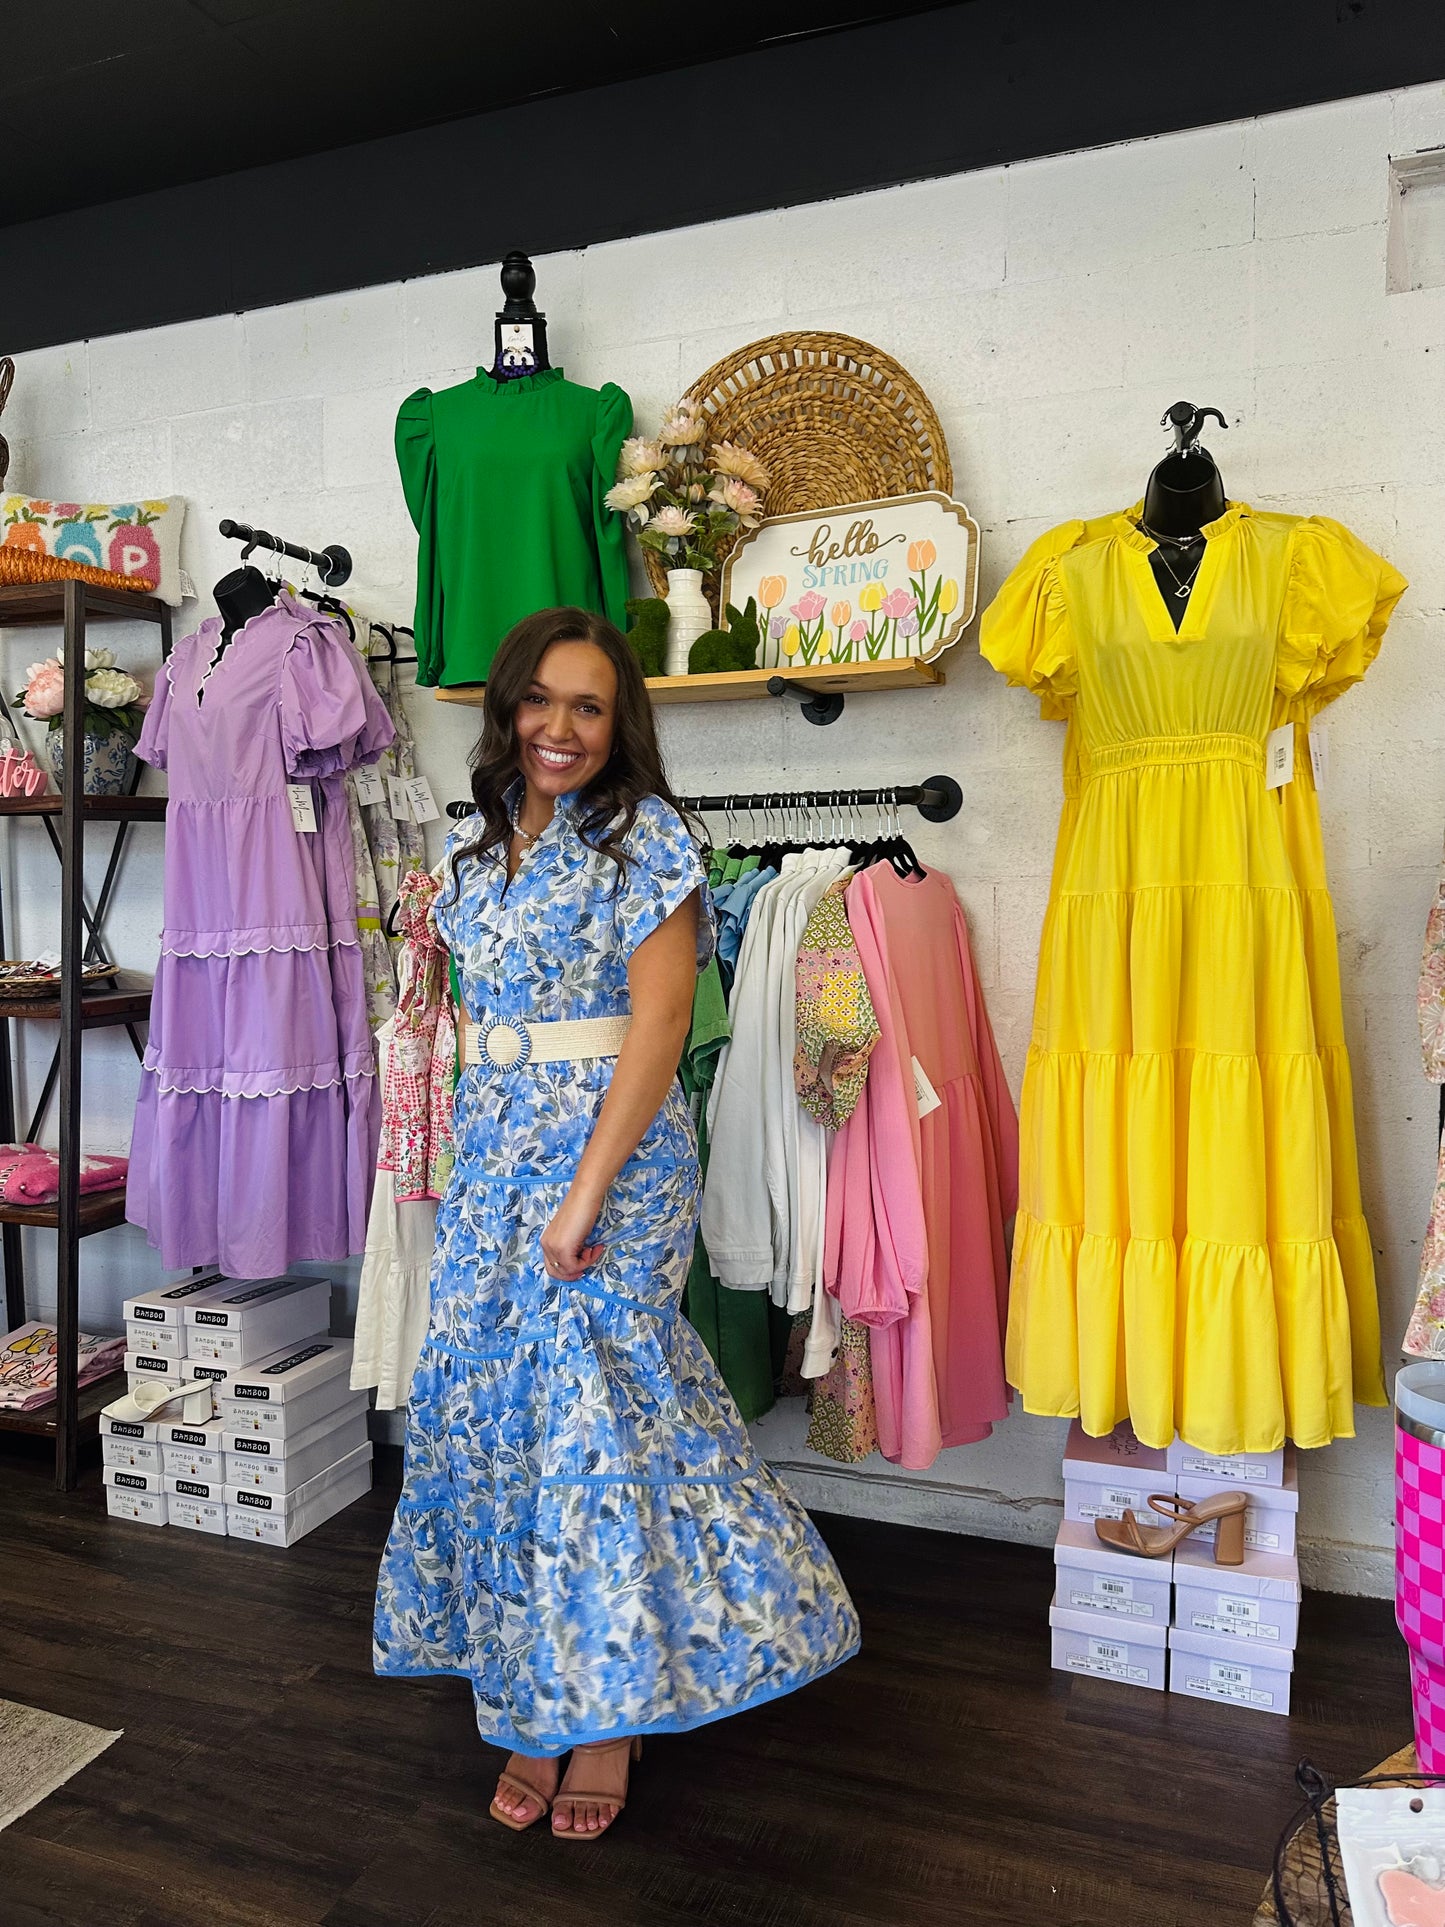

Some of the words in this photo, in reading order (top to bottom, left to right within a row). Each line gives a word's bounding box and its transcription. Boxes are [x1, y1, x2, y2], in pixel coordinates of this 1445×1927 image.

[790, 518, 907, 568] hello
[13, 543, 149, 577] OP
[802, 558, 889, 589] SPRING
[135, 1309, 164, 1320] BAMBOO
[197, 1314, 226, 1324] BAMBOO
[138, 1358, 166, 1370] BAMBOO
[196, 1369, 226, 1380] BAMBOO
[236, 1388, 268, 1397] BAMBOO
[112, 1424, 142, 1436] BAMBOO
[173, 1432, 204, 1444] BAMBOO
[236, 1441, 268, 1452] BAMBOO
[116, 1475, 146, 1487] BAMBOO
[178, 1483, 208, 1496] BAMBOO
[238, 1494, 270, 1507] BAMBOO
